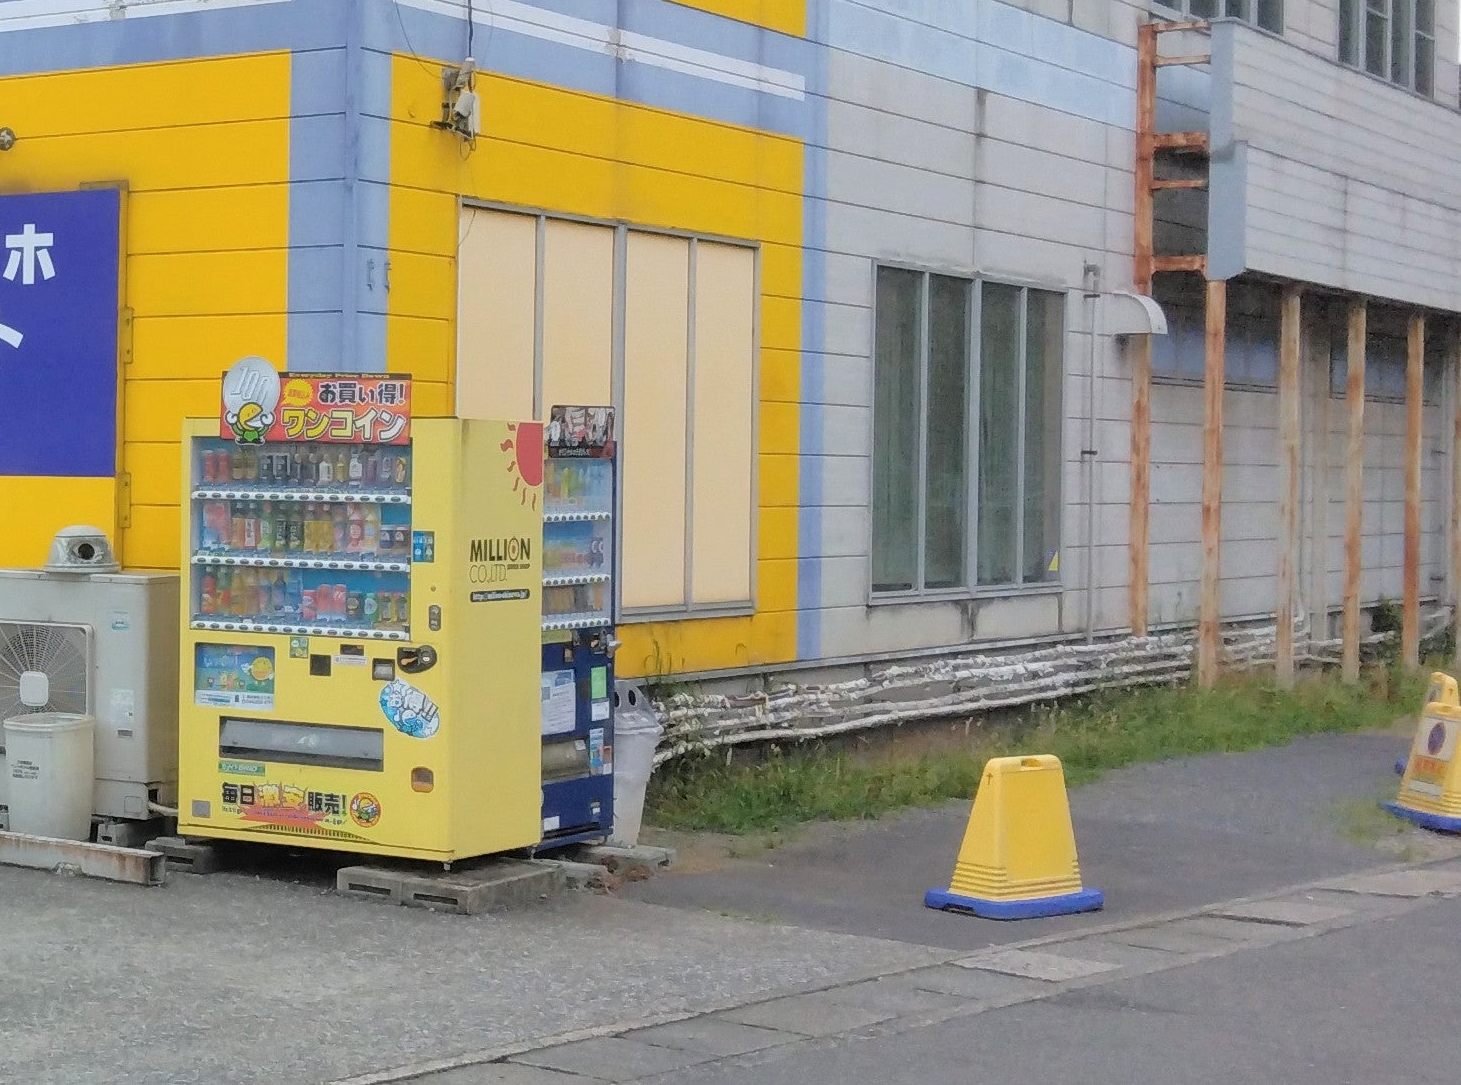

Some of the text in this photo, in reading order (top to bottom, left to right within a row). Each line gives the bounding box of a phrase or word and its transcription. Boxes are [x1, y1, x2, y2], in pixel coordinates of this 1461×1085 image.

[282, 407, 406, 441] ワンコイン
[469, 536, 531, 563] MILLION
